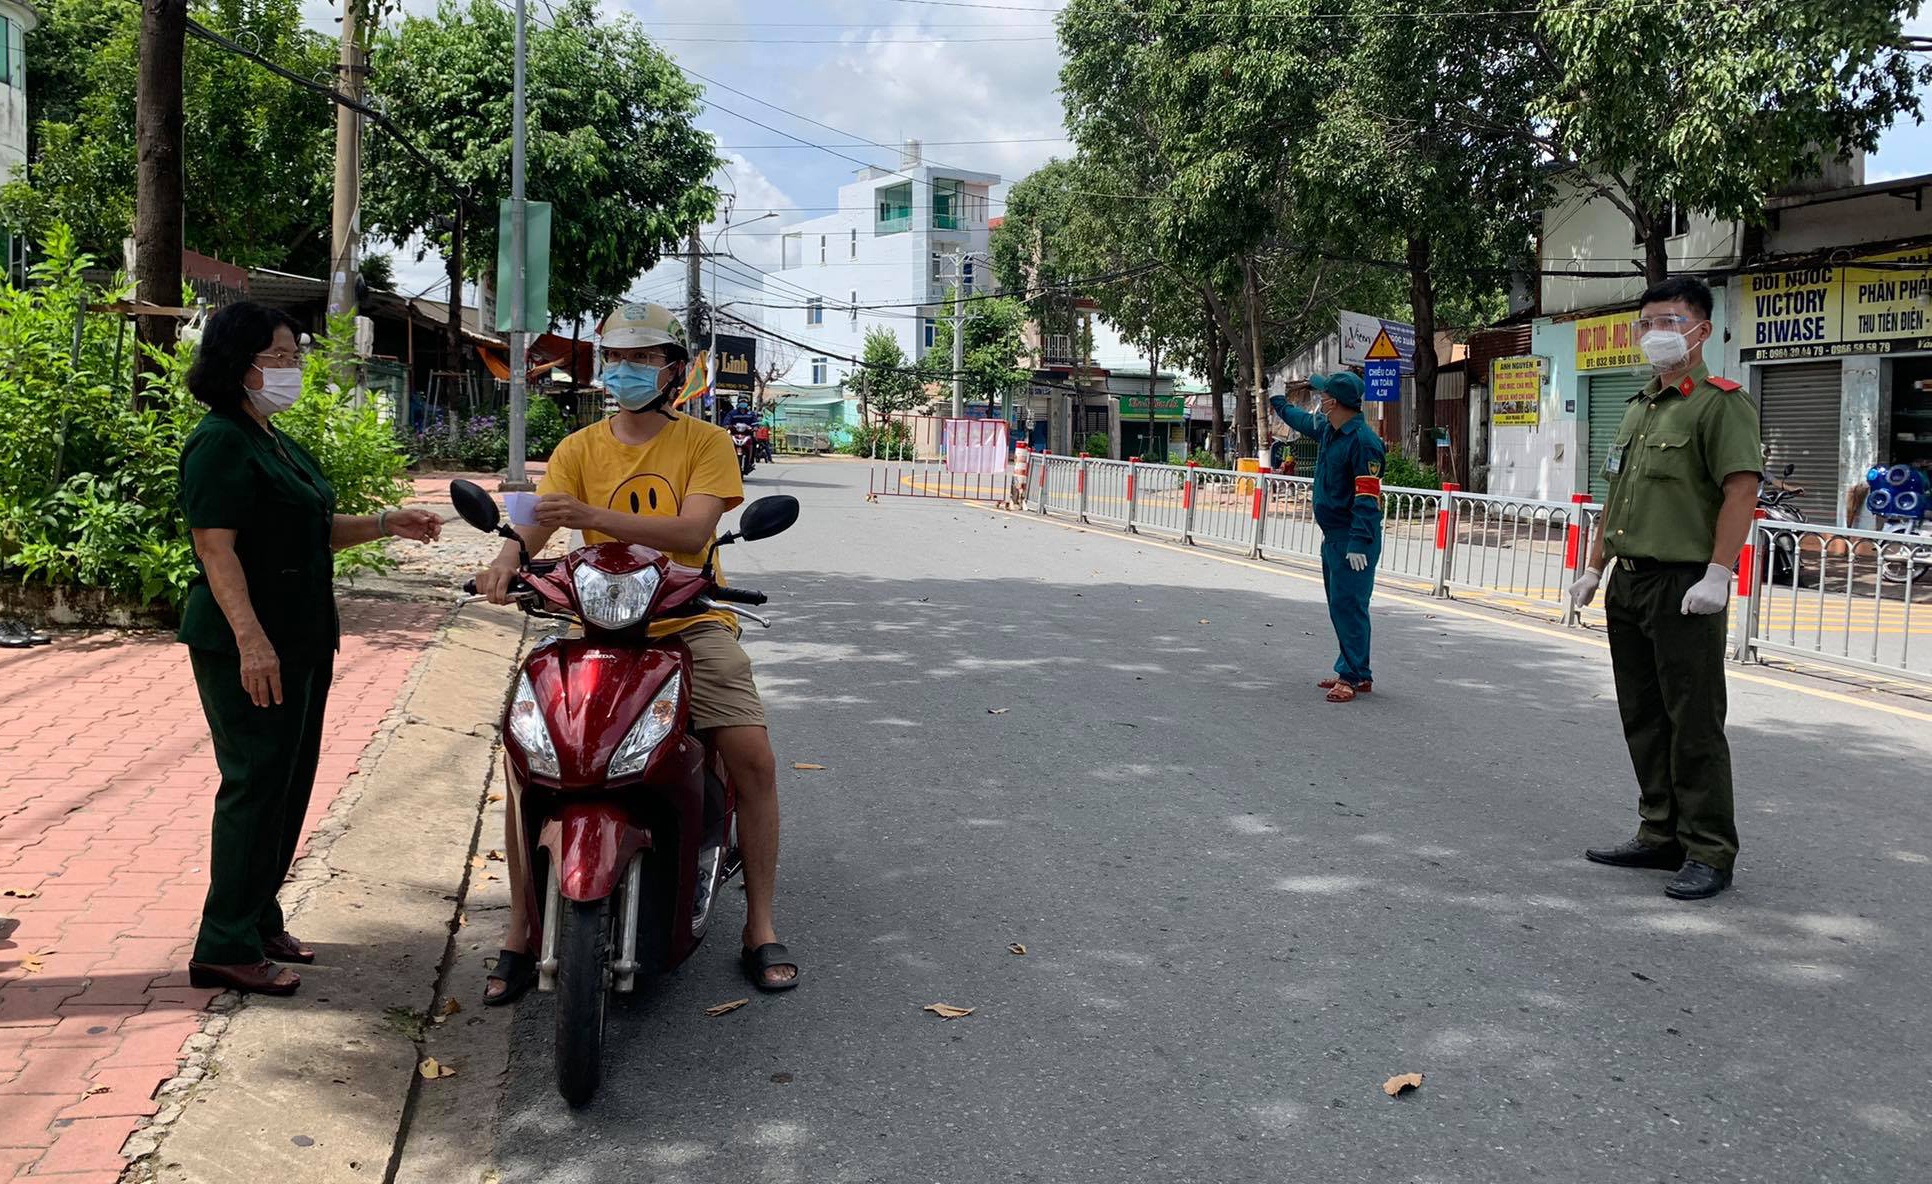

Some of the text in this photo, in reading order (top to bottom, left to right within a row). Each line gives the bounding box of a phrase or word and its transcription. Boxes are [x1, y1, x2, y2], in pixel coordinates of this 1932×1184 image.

[1756, 288, 1828, 318] VICTORY
[1858, 279, 1895, 304] PHÂN
[1756, 316, 1825, 345] BIWASE
[1858, 314, 1875, 333] THU
[1901, 306, 1923, 335] ĐIỆN
[1813, 345, 1824, 356] 79
[1385, 368, 1396, 376] CAO
